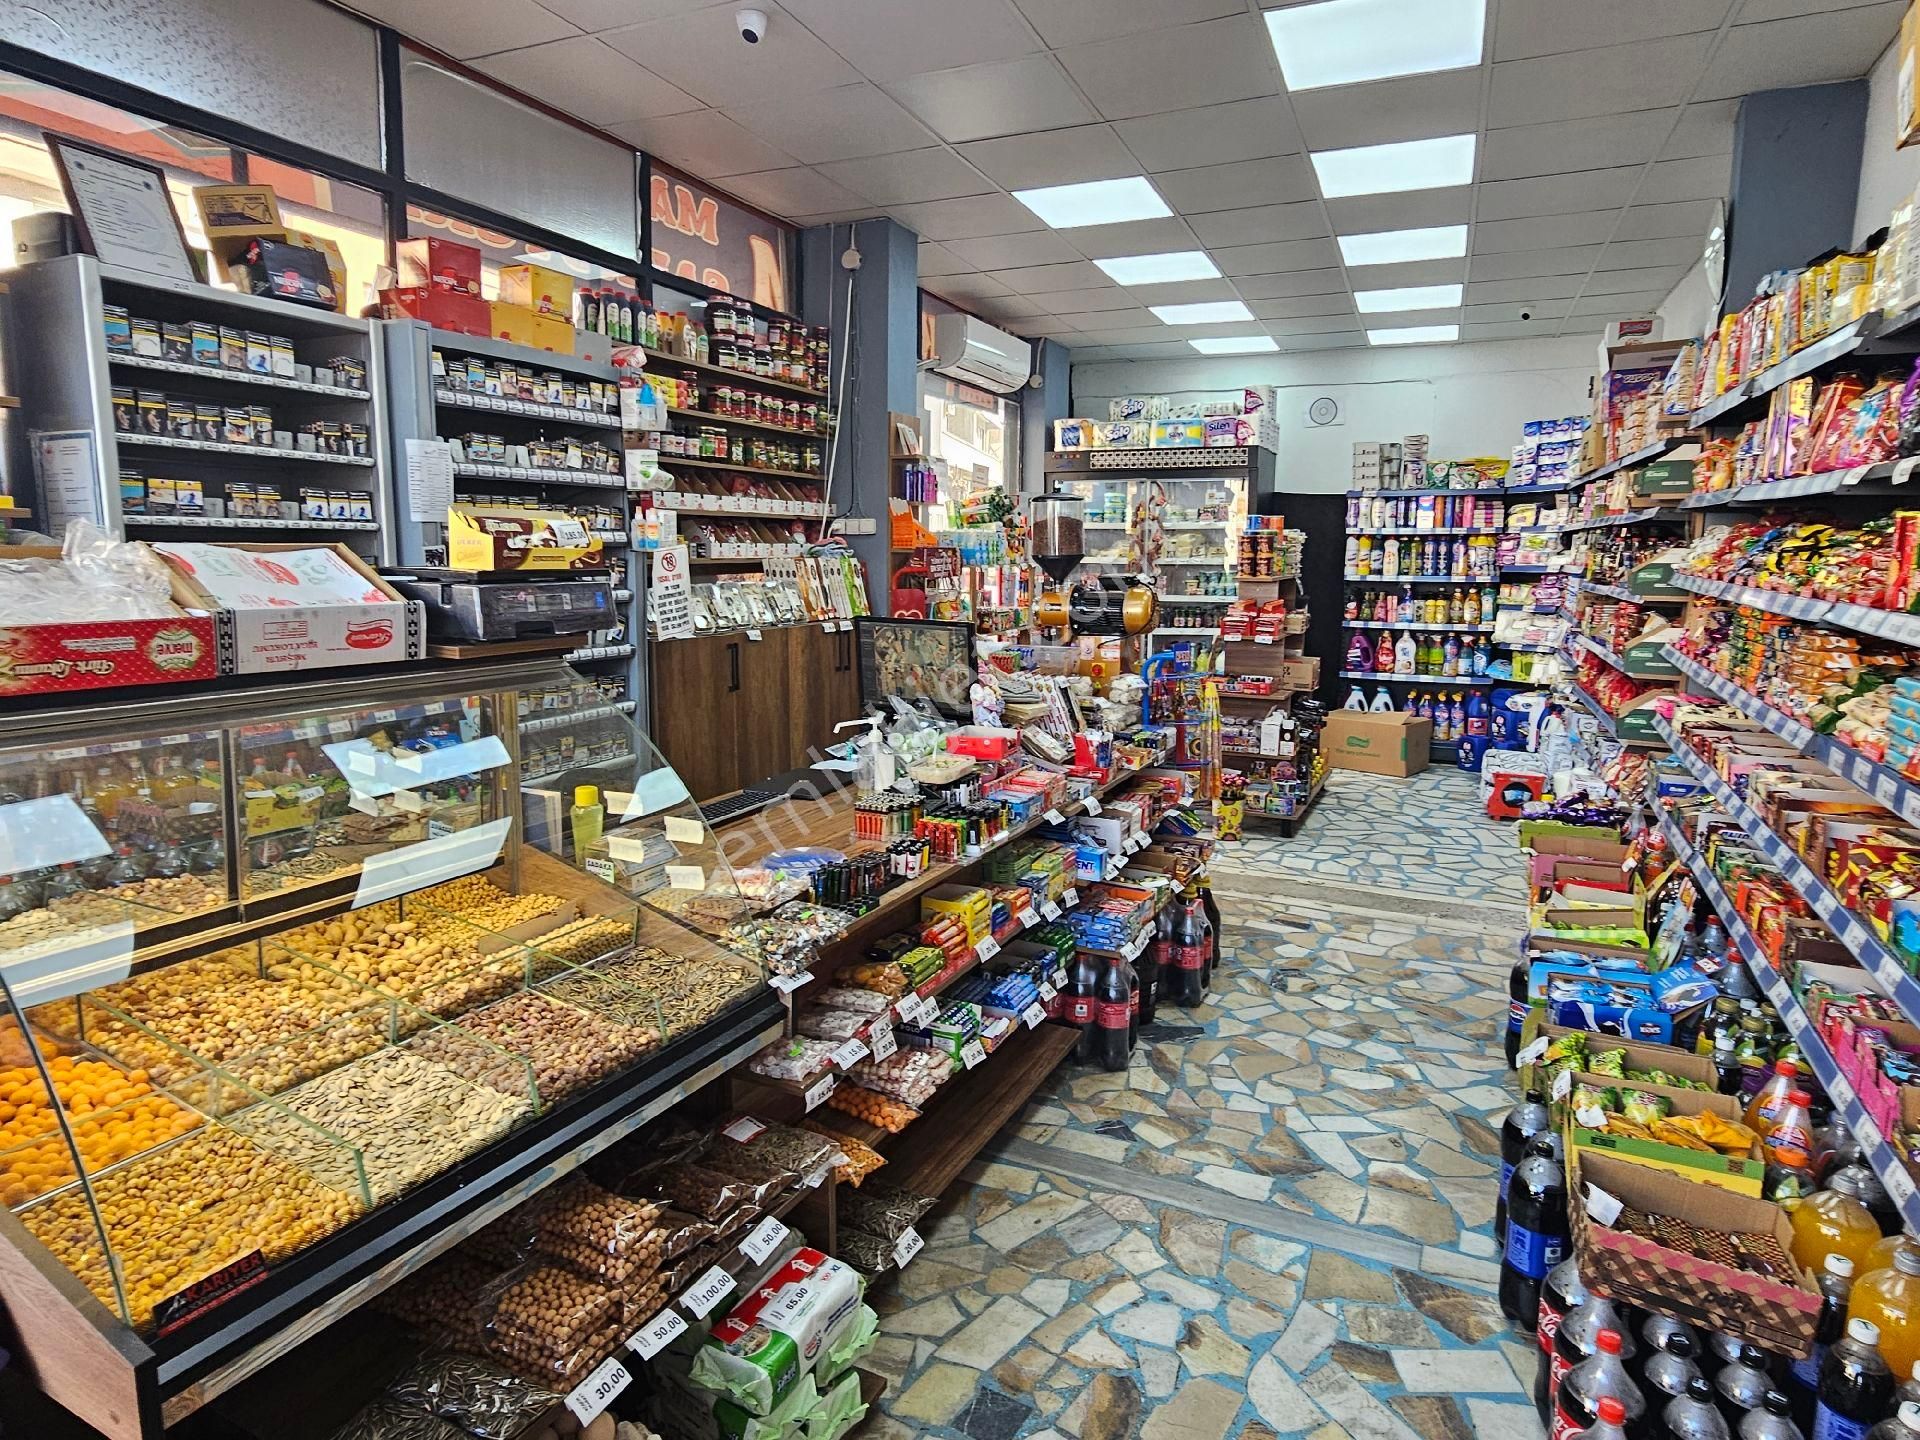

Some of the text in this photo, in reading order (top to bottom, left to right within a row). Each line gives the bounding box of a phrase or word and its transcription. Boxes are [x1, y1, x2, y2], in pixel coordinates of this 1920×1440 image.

[1120, 400, 1145, 418] Solo
[1105, 425, 1131, 442] Solo
[1208, 421, 1230, 432] Silen
[761, 1223, 783, 1246] 50,00
[701, 1274, 731, 1303] 100,00
[785, 1287, 809, 1310] 65,00
[653, 1315, 682, 1340] 50,00
[595, 1366, 626, 1400] 30,00
